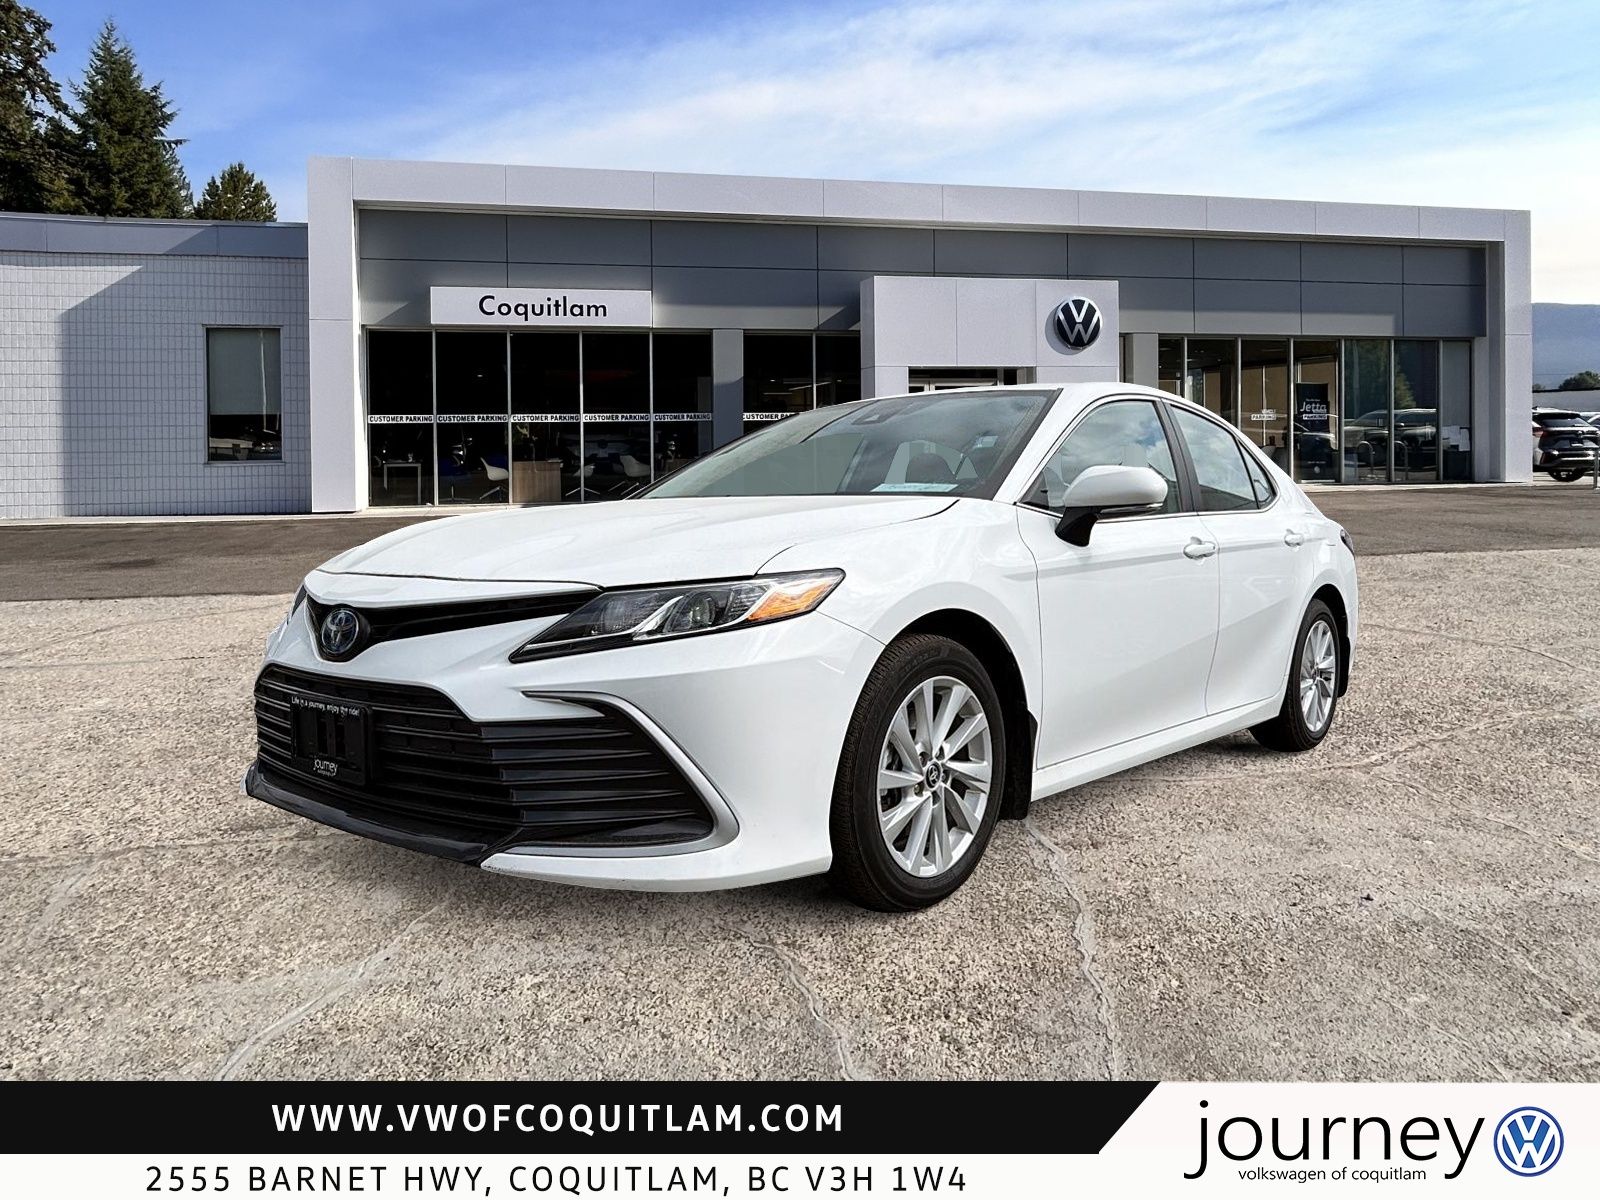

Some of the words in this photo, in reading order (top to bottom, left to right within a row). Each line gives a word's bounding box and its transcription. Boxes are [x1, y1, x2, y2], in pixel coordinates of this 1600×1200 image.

[478, 295, 607, 321] Coquitlam
[1300, 401, 1327, 412] Jetta
[369, 415, 404, 423] CUSTOMER
[512, 414, 548, 422] CUSTOMER
[550, 414, 580, 422] PARKING
[654, 413, 685, 421] CUSTOMER
